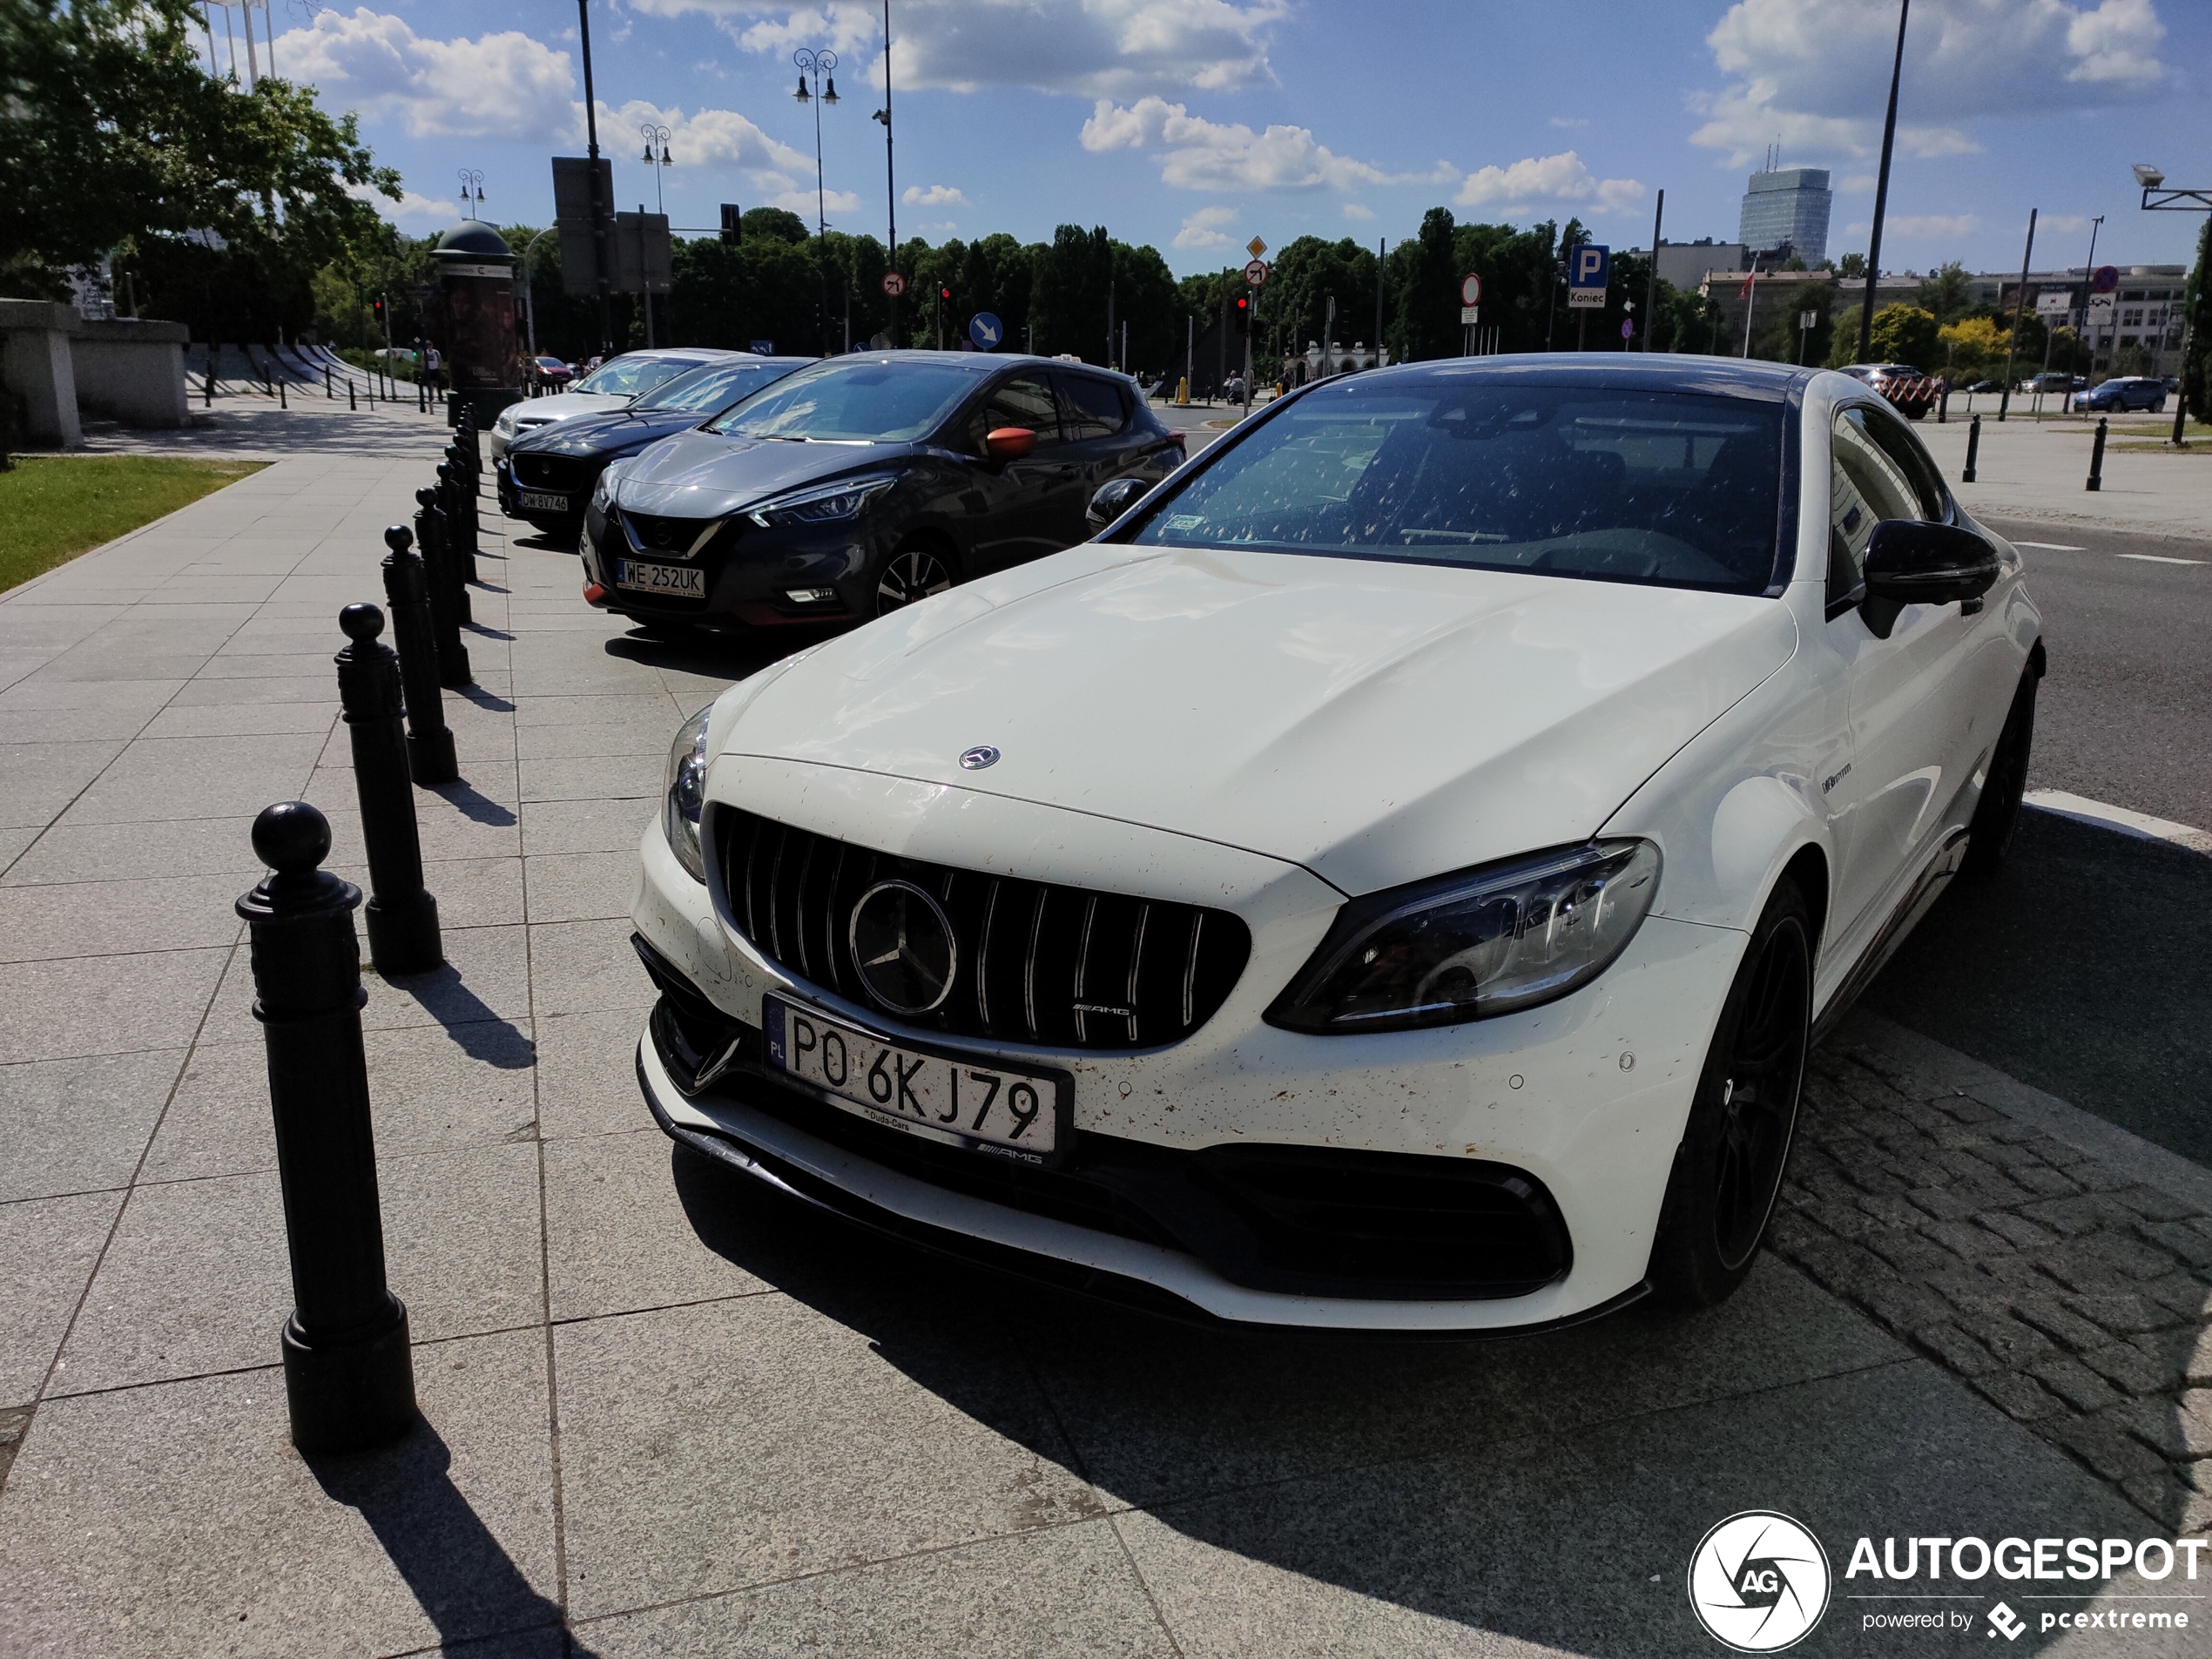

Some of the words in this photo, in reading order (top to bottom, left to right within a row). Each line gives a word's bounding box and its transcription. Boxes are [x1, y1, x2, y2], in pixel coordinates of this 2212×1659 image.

[1579, 250, 1602, 282] P
[1571, 292, 1604, 302] Koniec
[523, 494, 536, 507] DW
[538, 496, 566, 509] 8V746
[627, 563, 646, 584] WE
[651, 566, 700, 590] 252UK
[1091, 1006, 1130, 1015] AMG
[770, 1041, 785, 1059] PL
[793, 1015, 847, 1087] PO
[867, 1049, 1039, 1139] 6KJ79
[870, 1111, 909, 1131] Duda-Cars
[997, 1148, 1042, 1164] AMG
